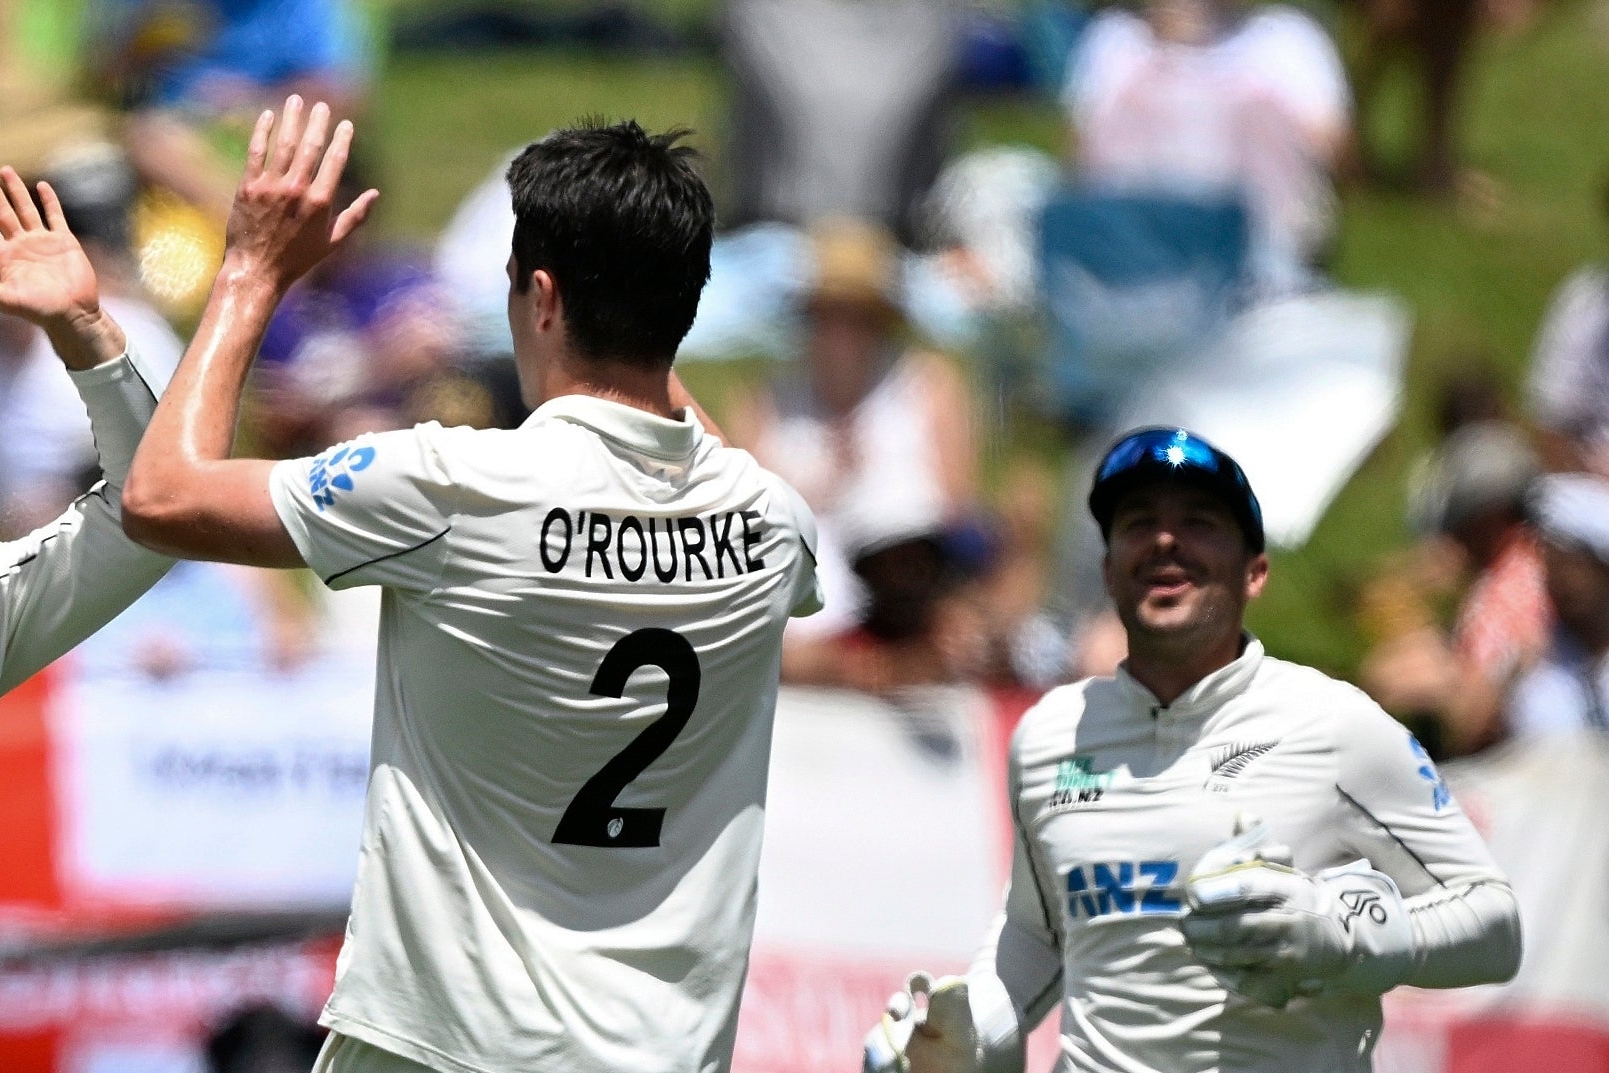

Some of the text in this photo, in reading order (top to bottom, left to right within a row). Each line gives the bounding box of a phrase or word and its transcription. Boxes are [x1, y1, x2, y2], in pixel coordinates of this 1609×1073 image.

[541, 507, 765, 583] O'ROURKE
[551, 627, 702, 847] 2
[1067, 860, 1182, 917] ANZ
